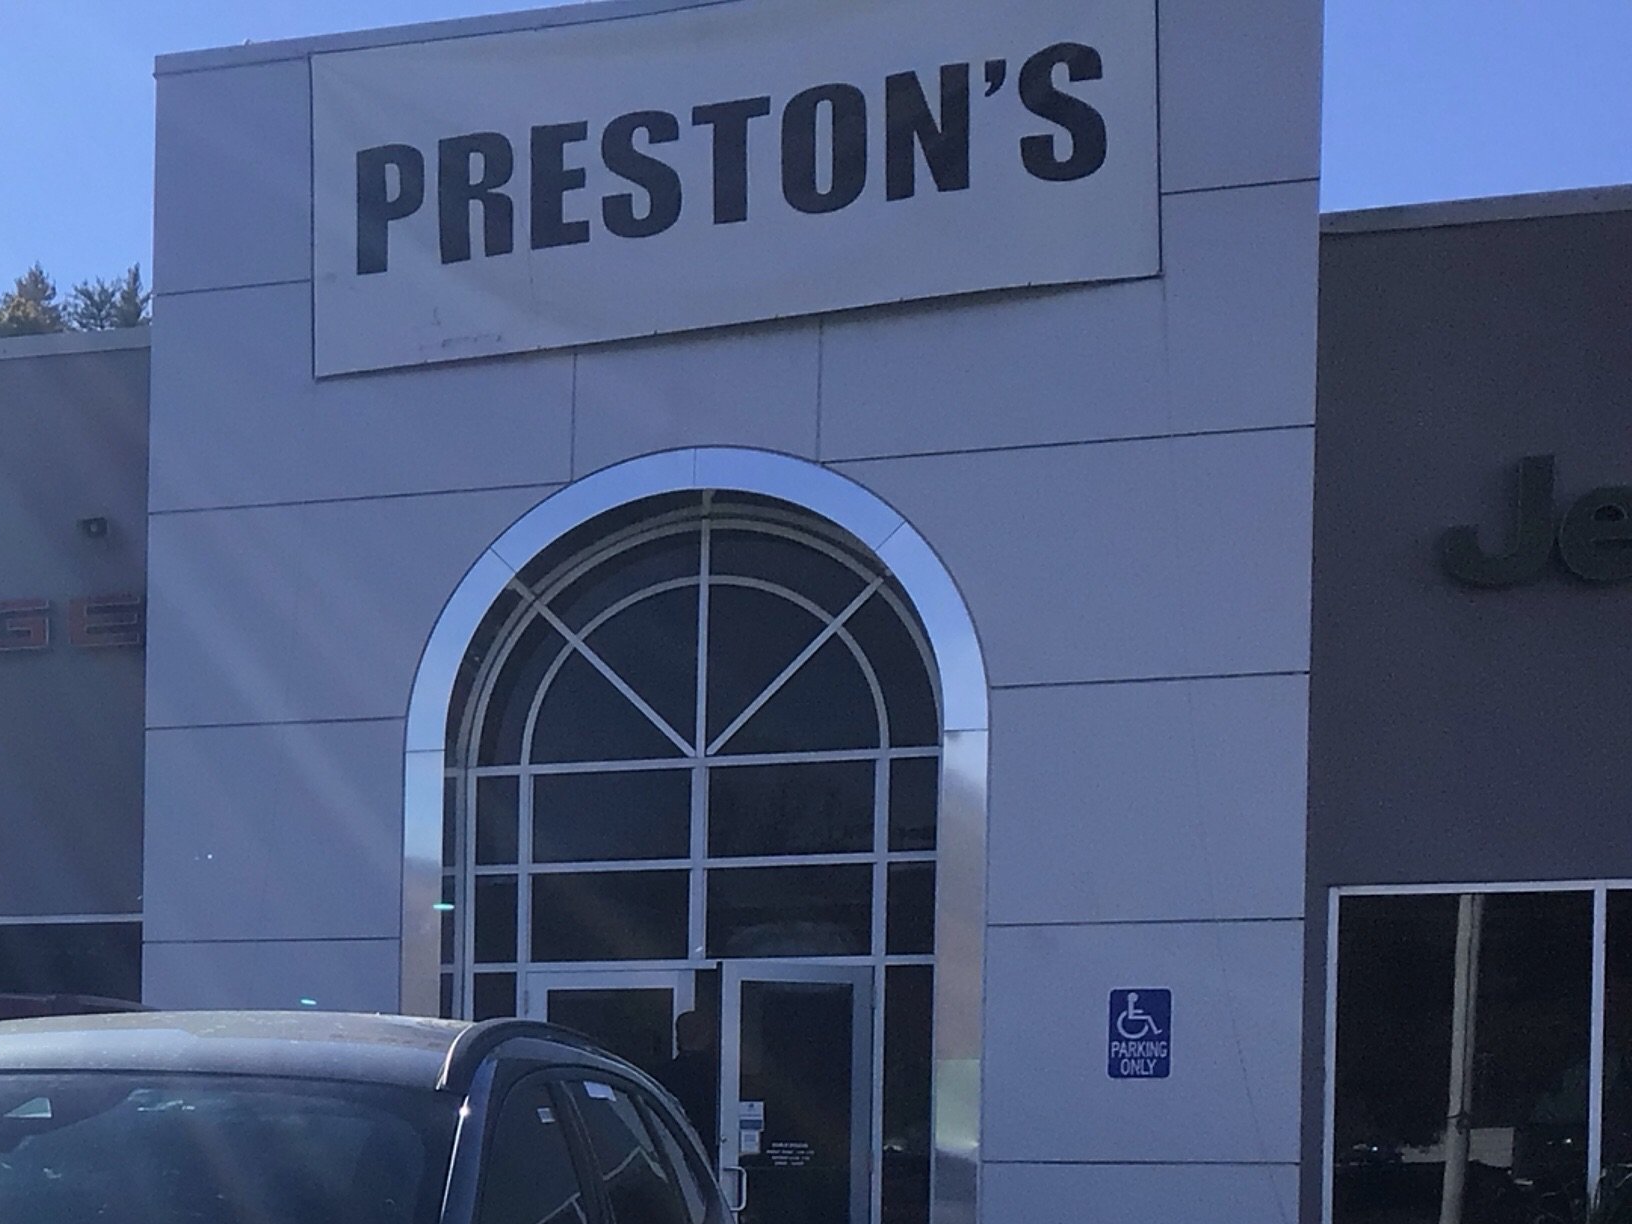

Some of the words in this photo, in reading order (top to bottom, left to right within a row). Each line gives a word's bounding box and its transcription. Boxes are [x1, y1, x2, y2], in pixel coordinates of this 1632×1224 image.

[356, 42, 1108, 275] PRESTON'S
[1111, 1041, 1167, 1058] PARKING
[1120, 1059, 1158, 1076] ONLY
